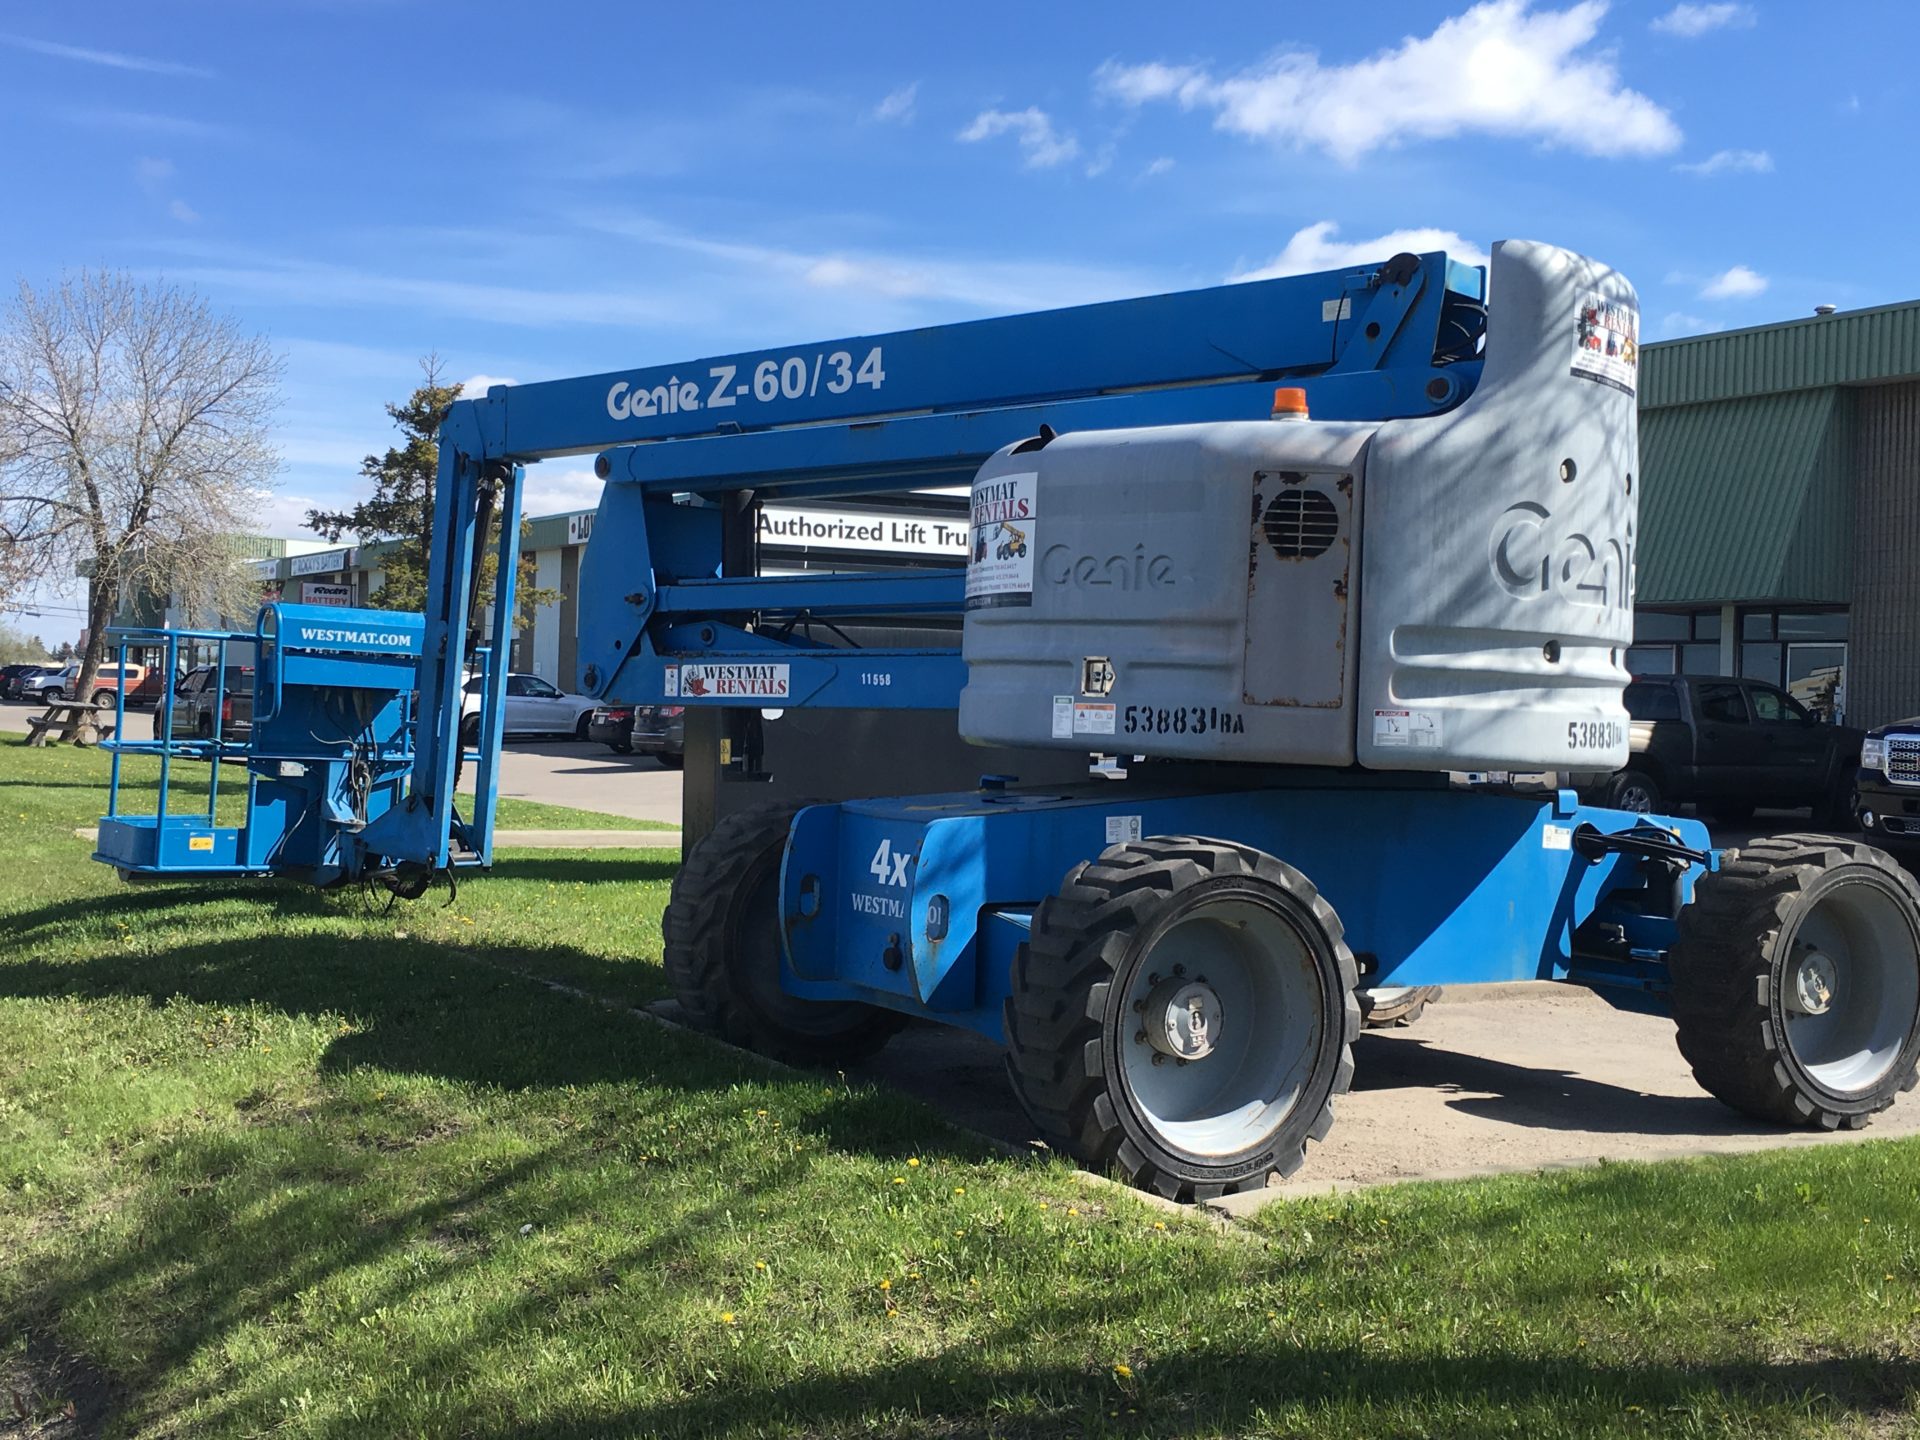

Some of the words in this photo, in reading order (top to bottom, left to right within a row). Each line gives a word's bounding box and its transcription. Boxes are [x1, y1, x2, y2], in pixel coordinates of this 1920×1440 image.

[607, 375, 700, 420] Genie
[707, 347, 886, 409] Z-60/34
[974, 498, 1029, 527] RENTALS
[758, 513, 883, 542] Authorized
[891, 522, 926, 544] Lift
[933, 525, 967, 547] Tru
[1041, 542, 1176, 592] Genie
[1488, 501, 1635, 611] Geni
[305, 596, 347, 605] BATTERY
[301, 627, 411, 647] WESTMAT.COM
[703, 666, 777, 680] WESTMAT
[861, 673, 891, 686] 11558
[716, 679, 787, 695] RENTALS
